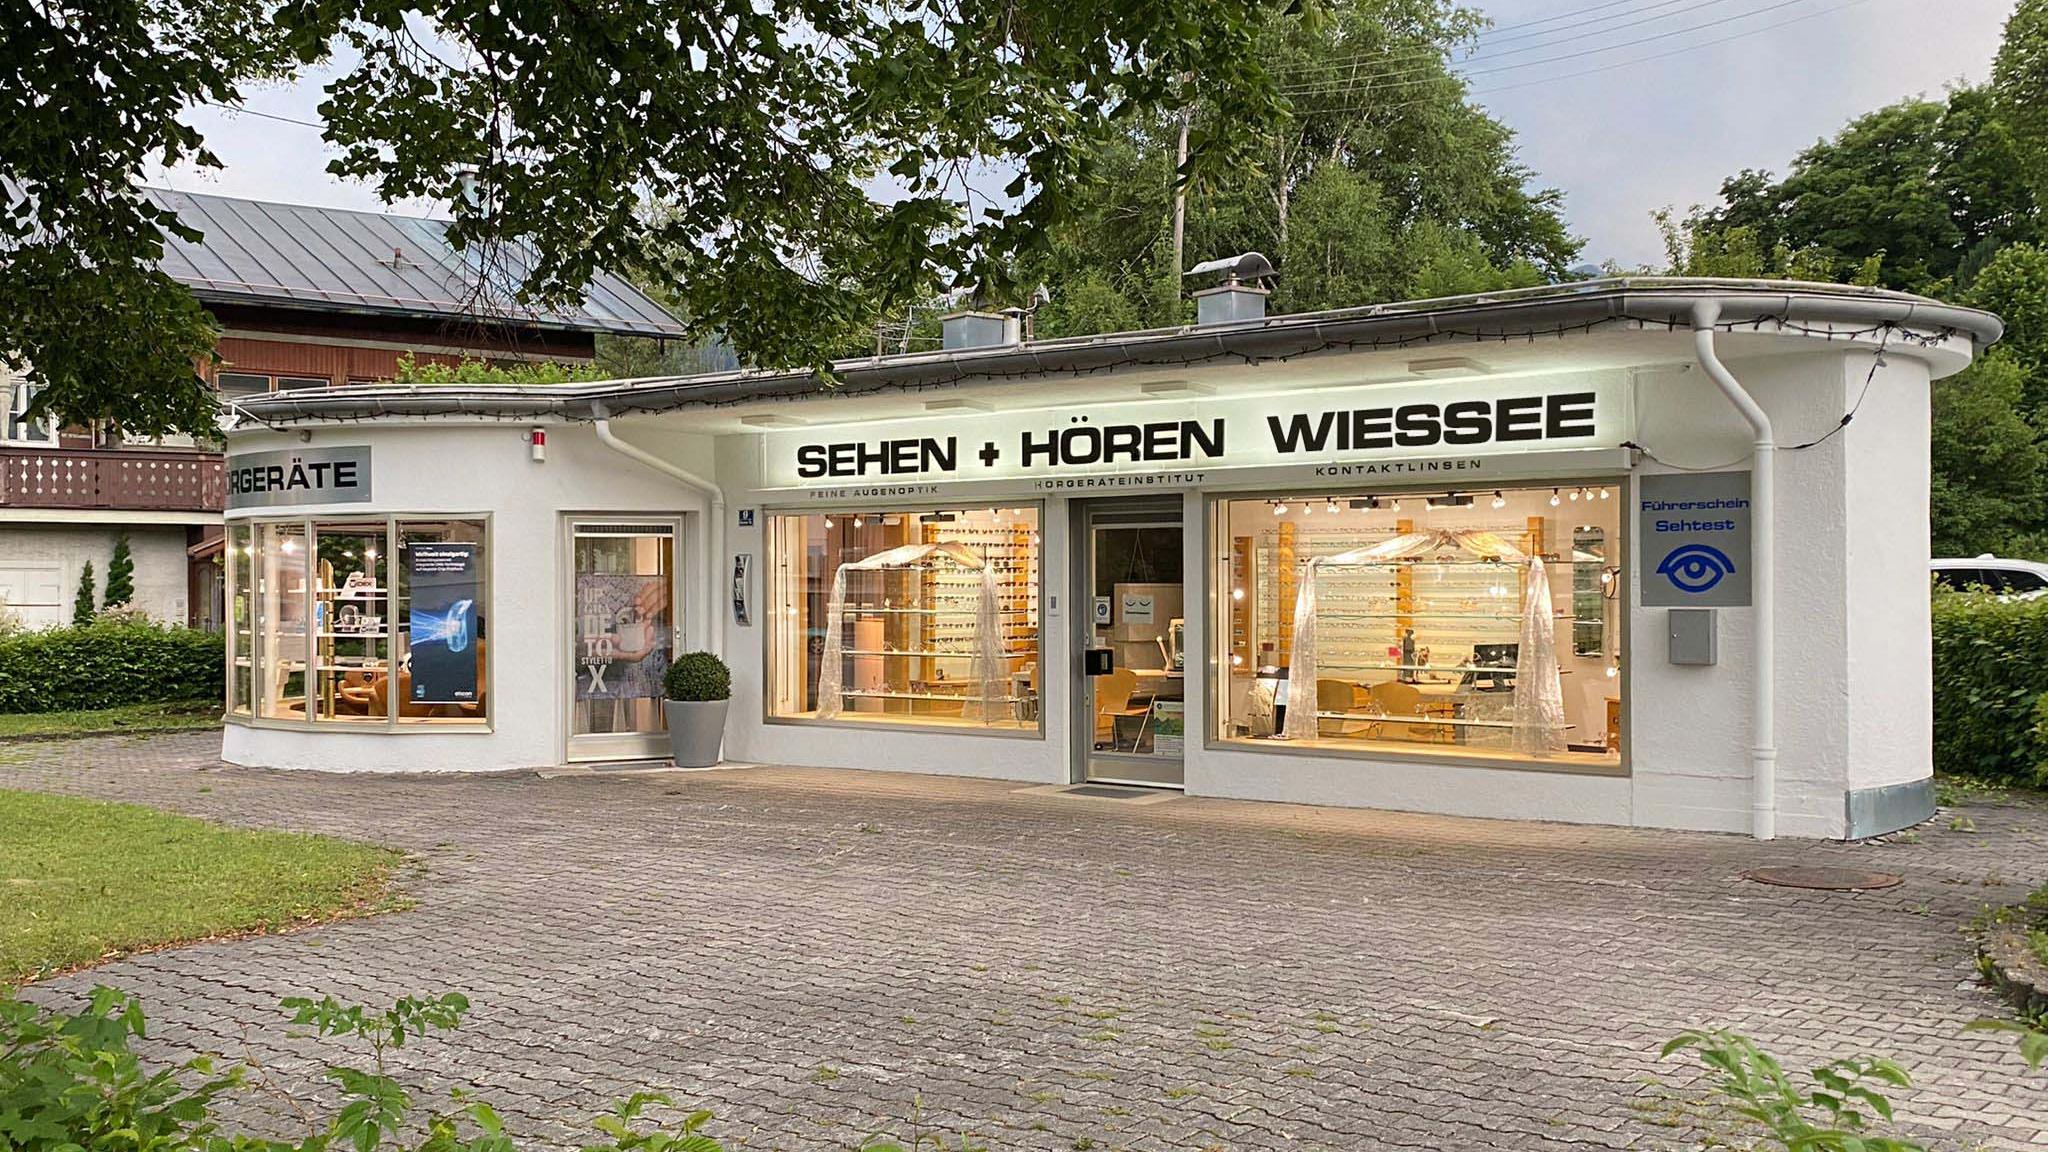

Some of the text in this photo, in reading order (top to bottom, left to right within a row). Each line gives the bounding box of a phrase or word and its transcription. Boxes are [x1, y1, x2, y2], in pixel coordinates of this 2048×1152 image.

[797, 392, 1596, 478] SEHEN + HÖREN WIESSEE
[1315, 460, 1481, 476] KONTAKTLINSEN
[810, 486, 938, 499] FEINE AUGENOPTIK
[1641, 498, 1749, 511] Führerschein
[1655, 519, 1735, 532] Sehtest
[584, 639, 613, 657] TO
[588, 665, 608, 693] X
